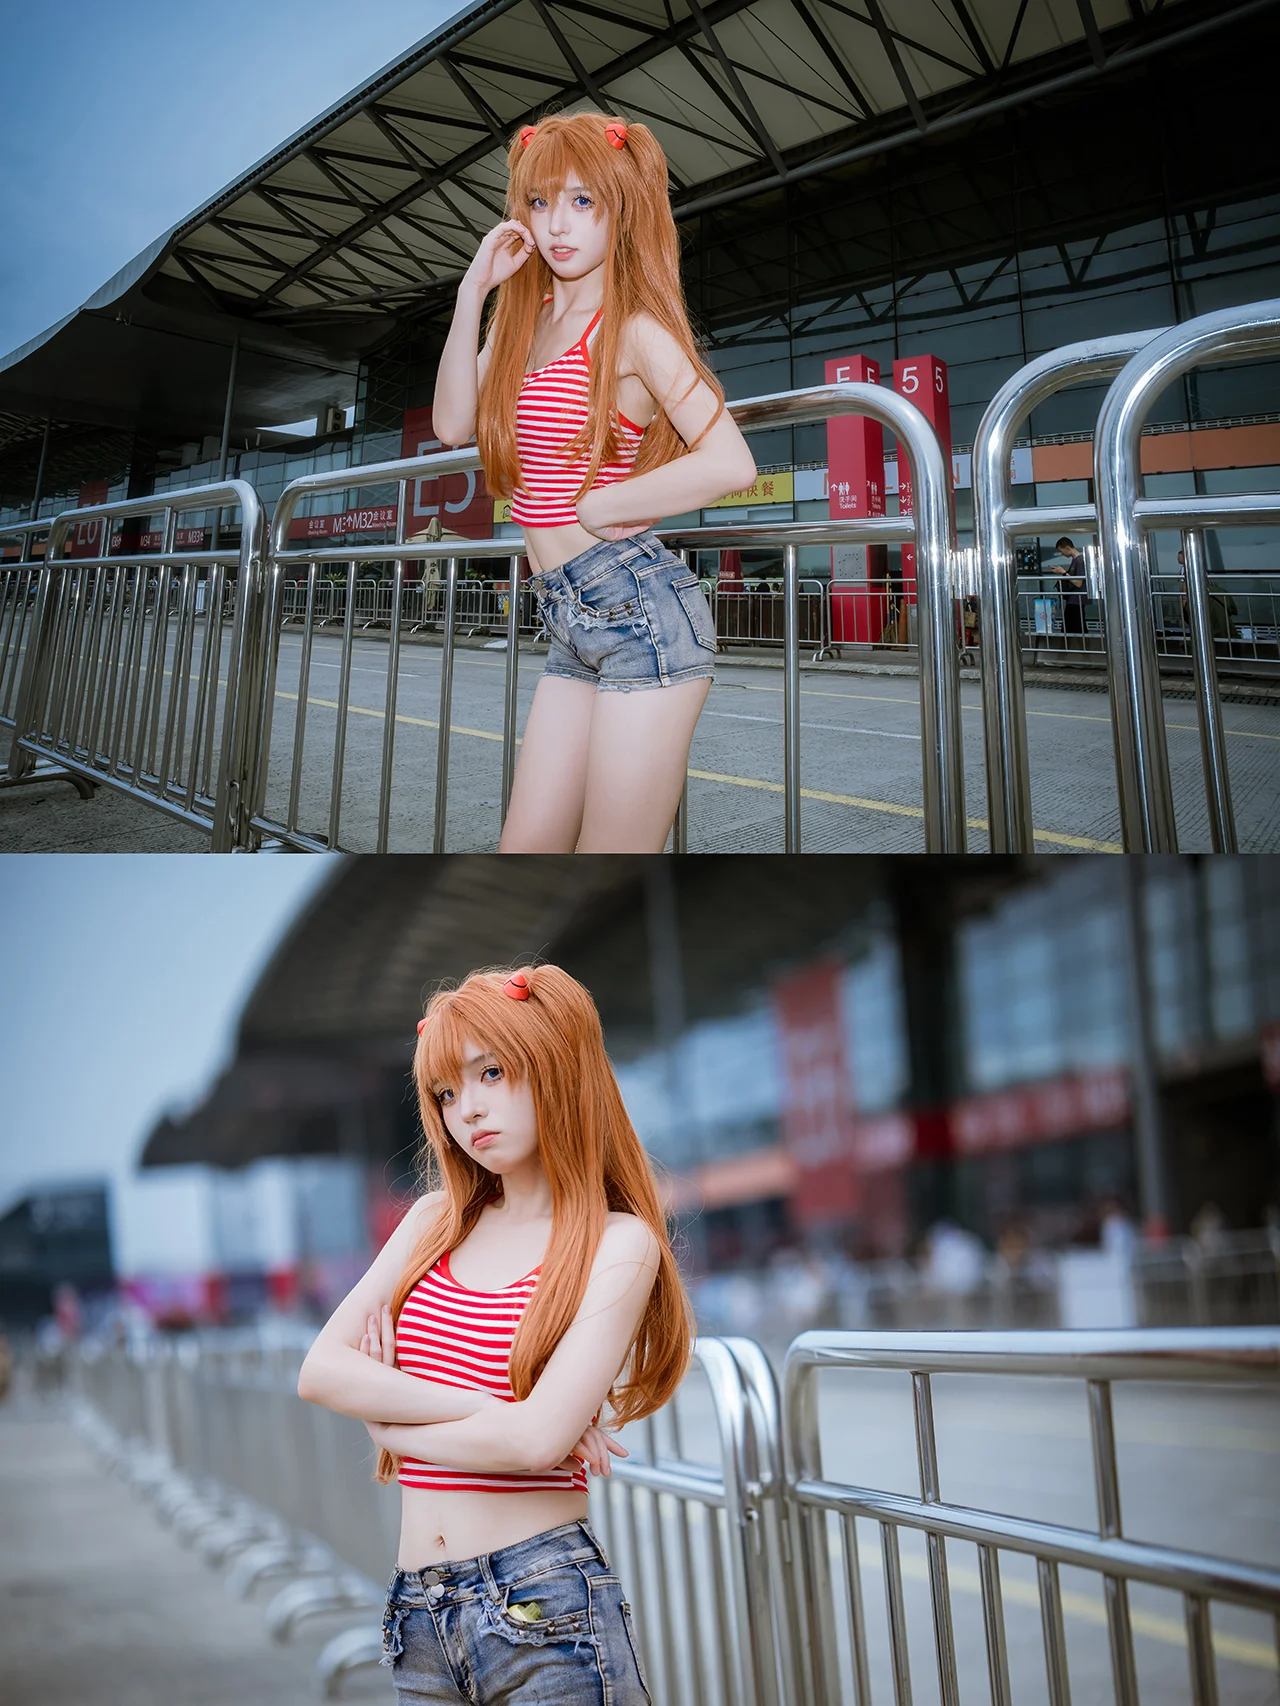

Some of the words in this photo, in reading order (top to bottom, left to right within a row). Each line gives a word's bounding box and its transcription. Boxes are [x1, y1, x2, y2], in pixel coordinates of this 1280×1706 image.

[901, 366, 919, 394] 5
[935, 366, 943, 393] 5
[722, 481, 775, 500] 快餐
[352, 511, 373, 529] M32
[373, 510, 393, 521] 会议室
